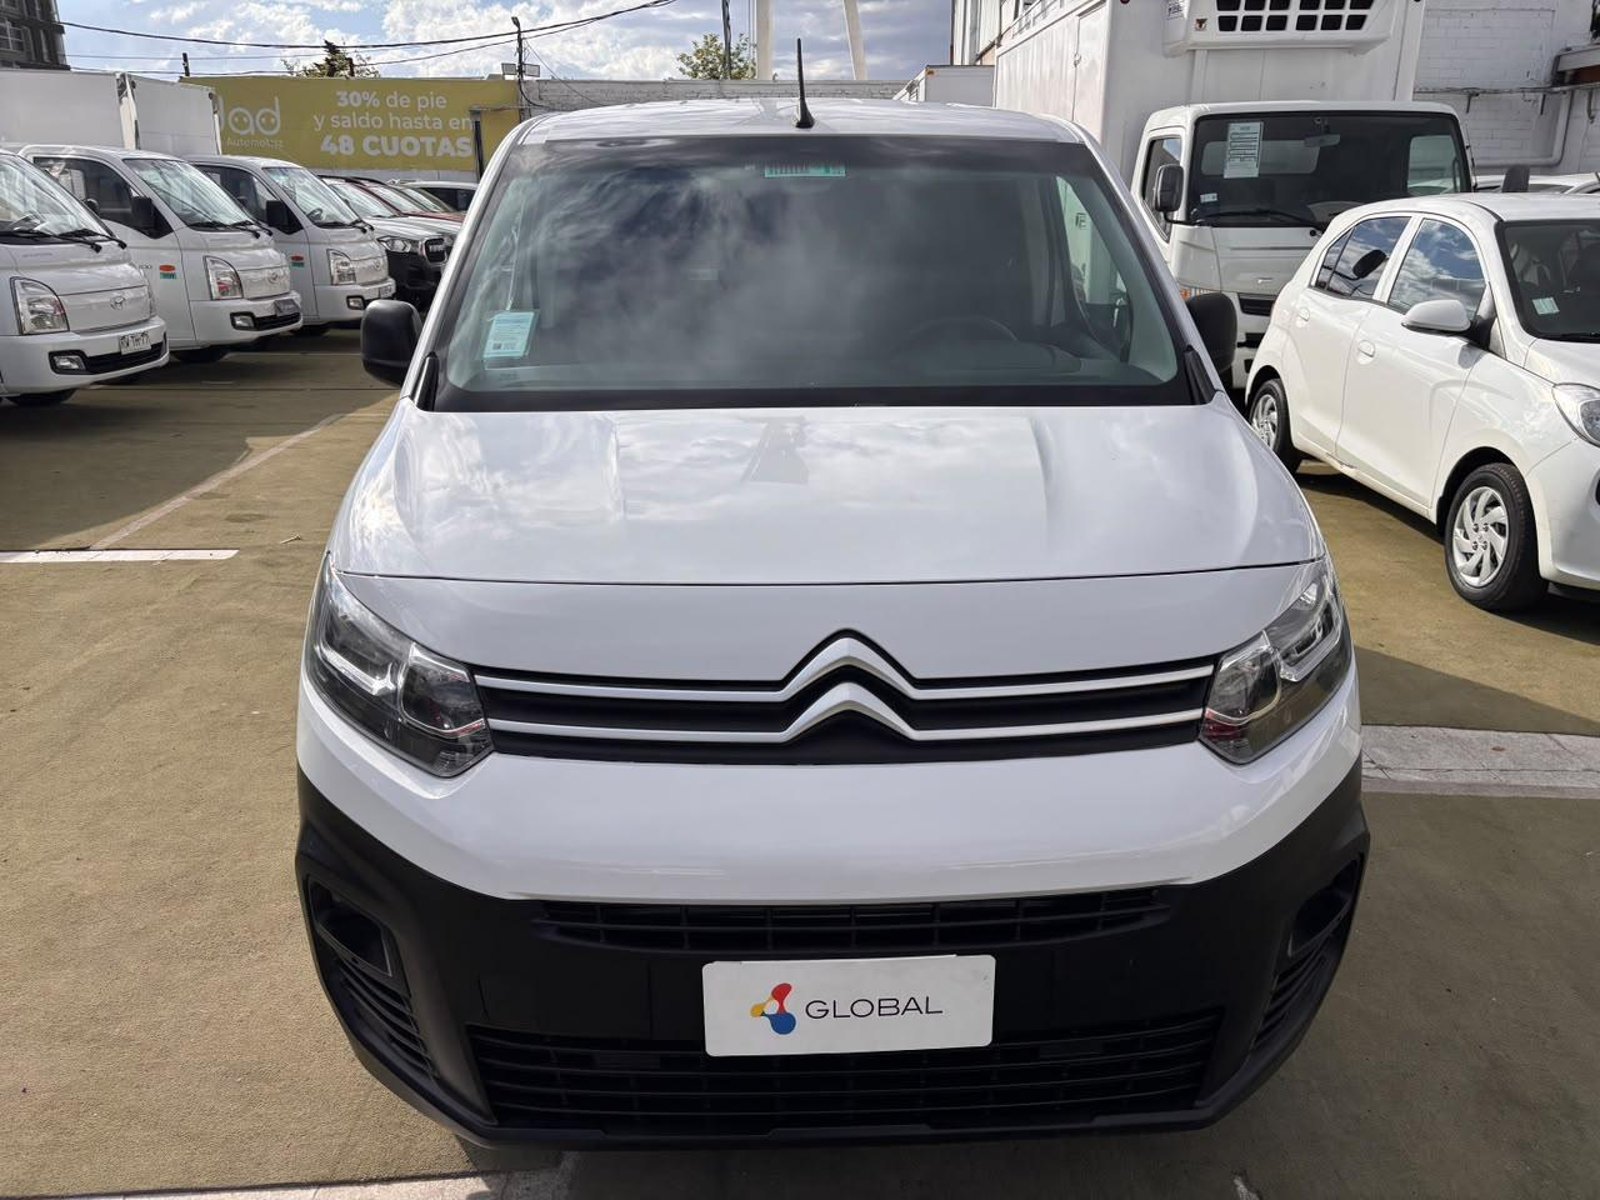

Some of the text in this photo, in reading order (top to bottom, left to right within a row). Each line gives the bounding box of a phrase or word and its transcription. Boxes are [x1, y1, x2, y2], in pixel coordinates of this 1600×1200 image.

[336, 90, 447, 112] 30% de pie
[313, 111, 474, 132] y saldo hasta en
[320, 135, 473, 157] 48 CUOTAS
[805, 996, 943, 1019] GLOBAL
